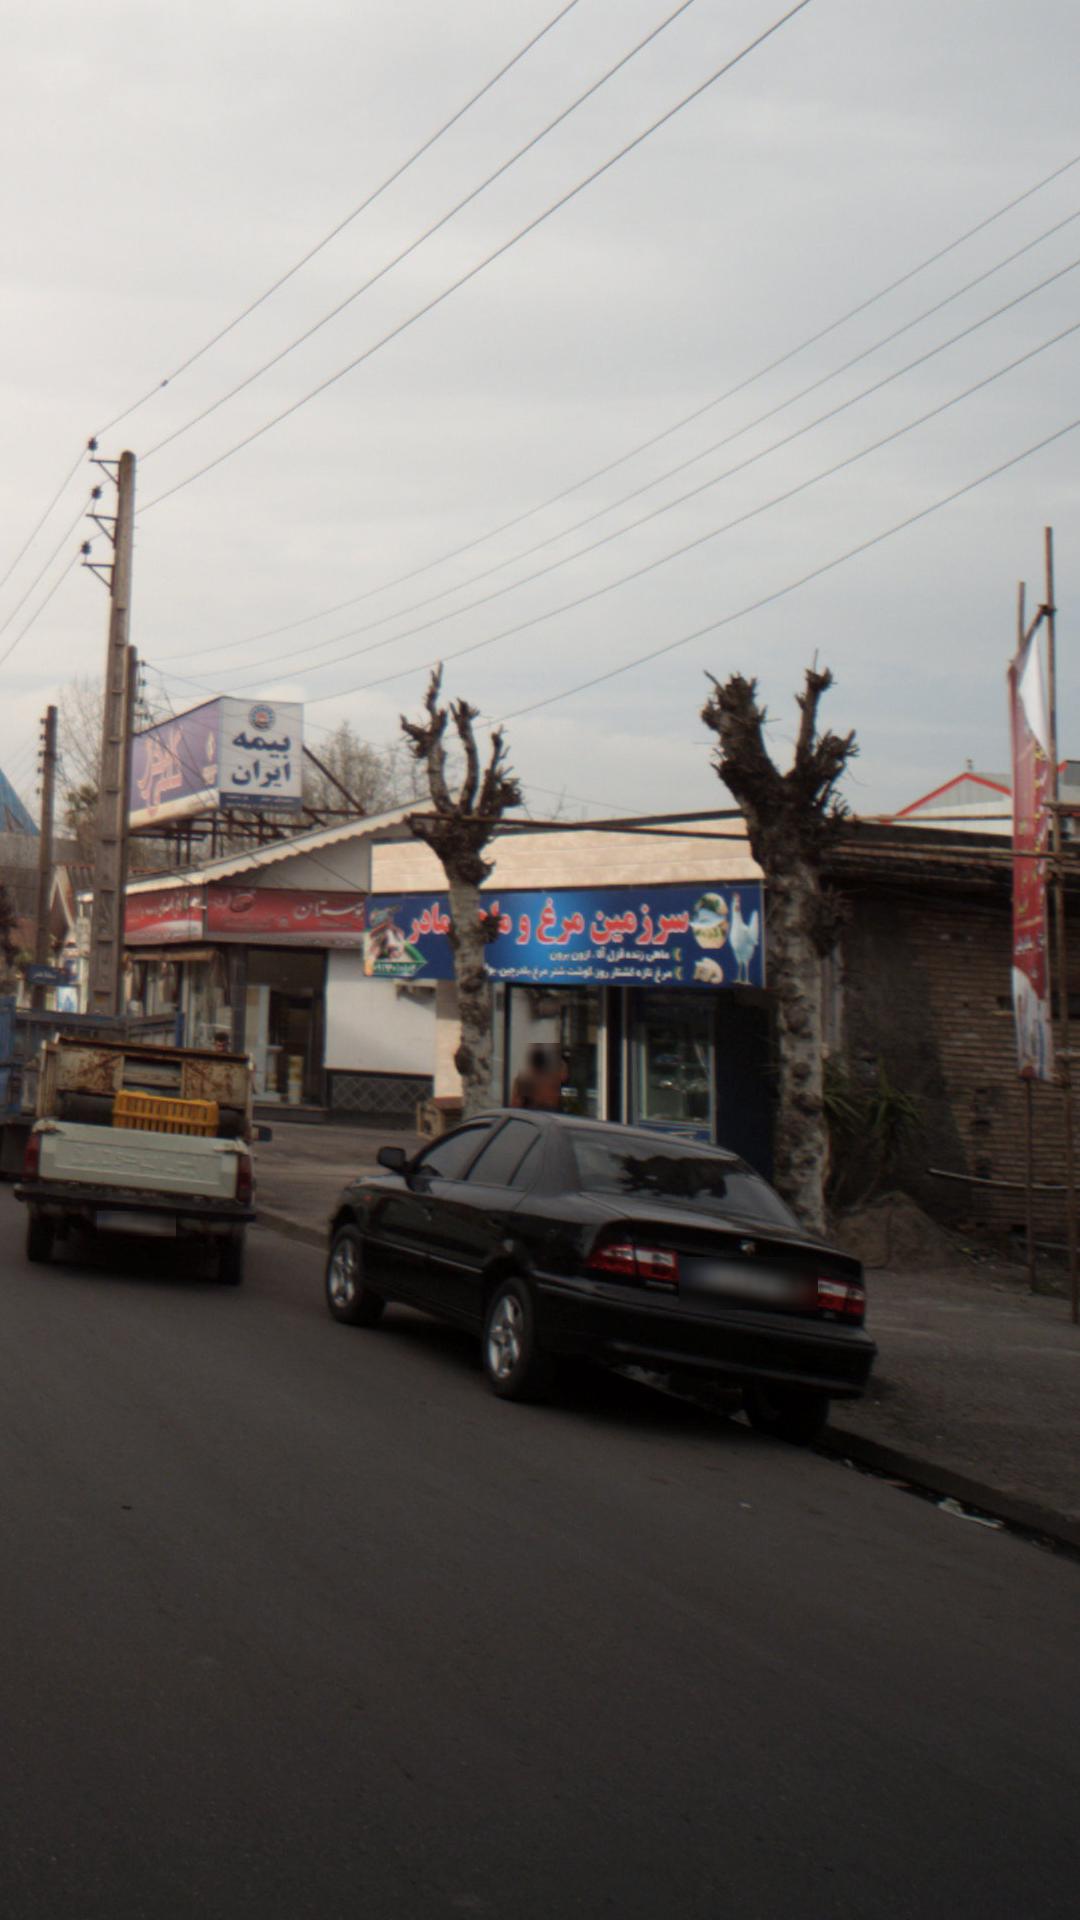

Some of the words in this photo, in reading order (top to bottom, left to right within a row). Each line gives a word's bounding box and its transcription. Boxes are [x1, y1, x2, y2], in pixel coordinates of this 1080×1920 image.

[231, 731, 291, 759] بیمه
[231, 759, 291, 787] ایران
[515, 914, 532, 945] و
[536, 896, 585, 945] مرغ
[590, 903, 690, 945] سرزمین
[643, 949, 671, 963] ماهی
